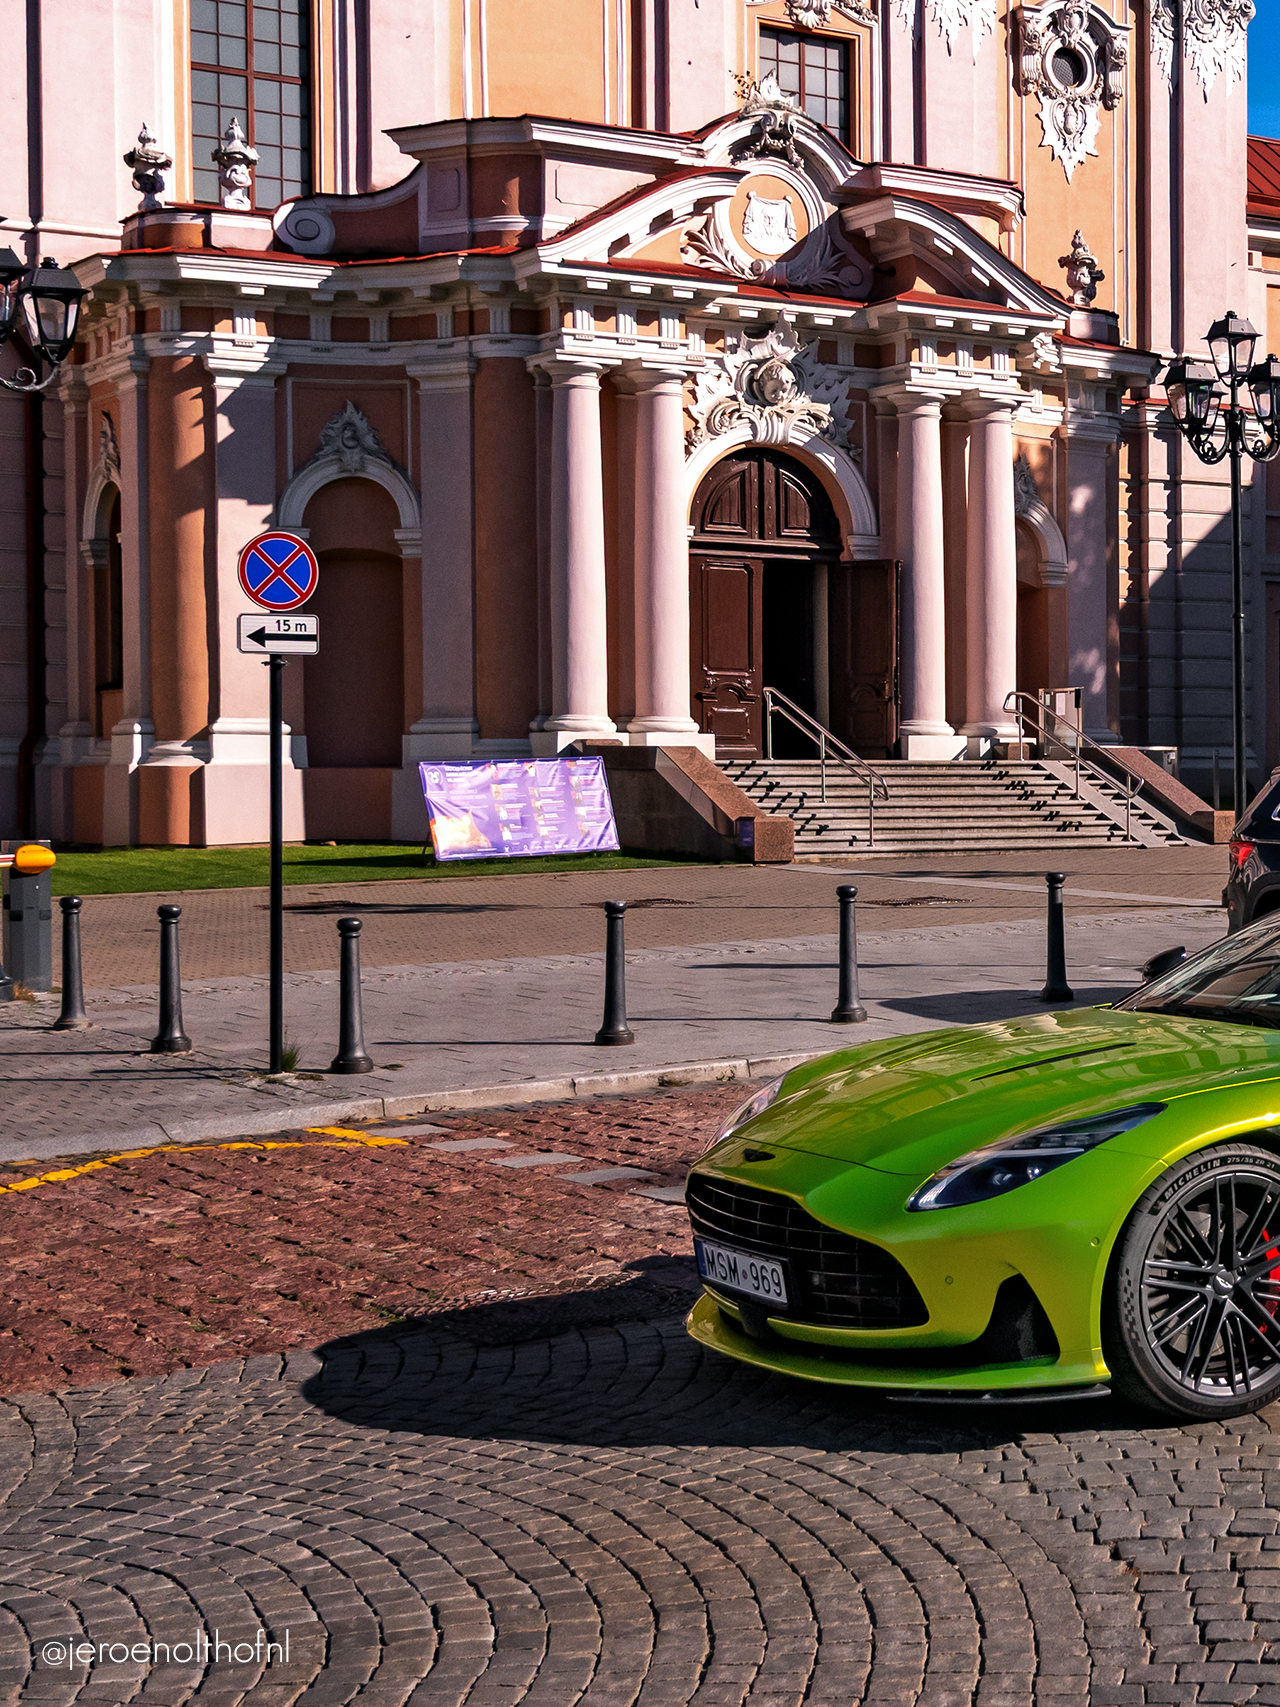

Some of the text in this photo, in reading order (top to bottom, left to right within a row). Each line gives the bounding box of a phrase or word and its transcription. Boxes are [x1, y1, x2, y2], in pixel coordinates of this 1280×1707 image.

[275, 619, 307, 632] 15 m
[1164, 1158, 1221, 1200] MICHELIN
[704, 1246, 782, 1297] MSM 969
